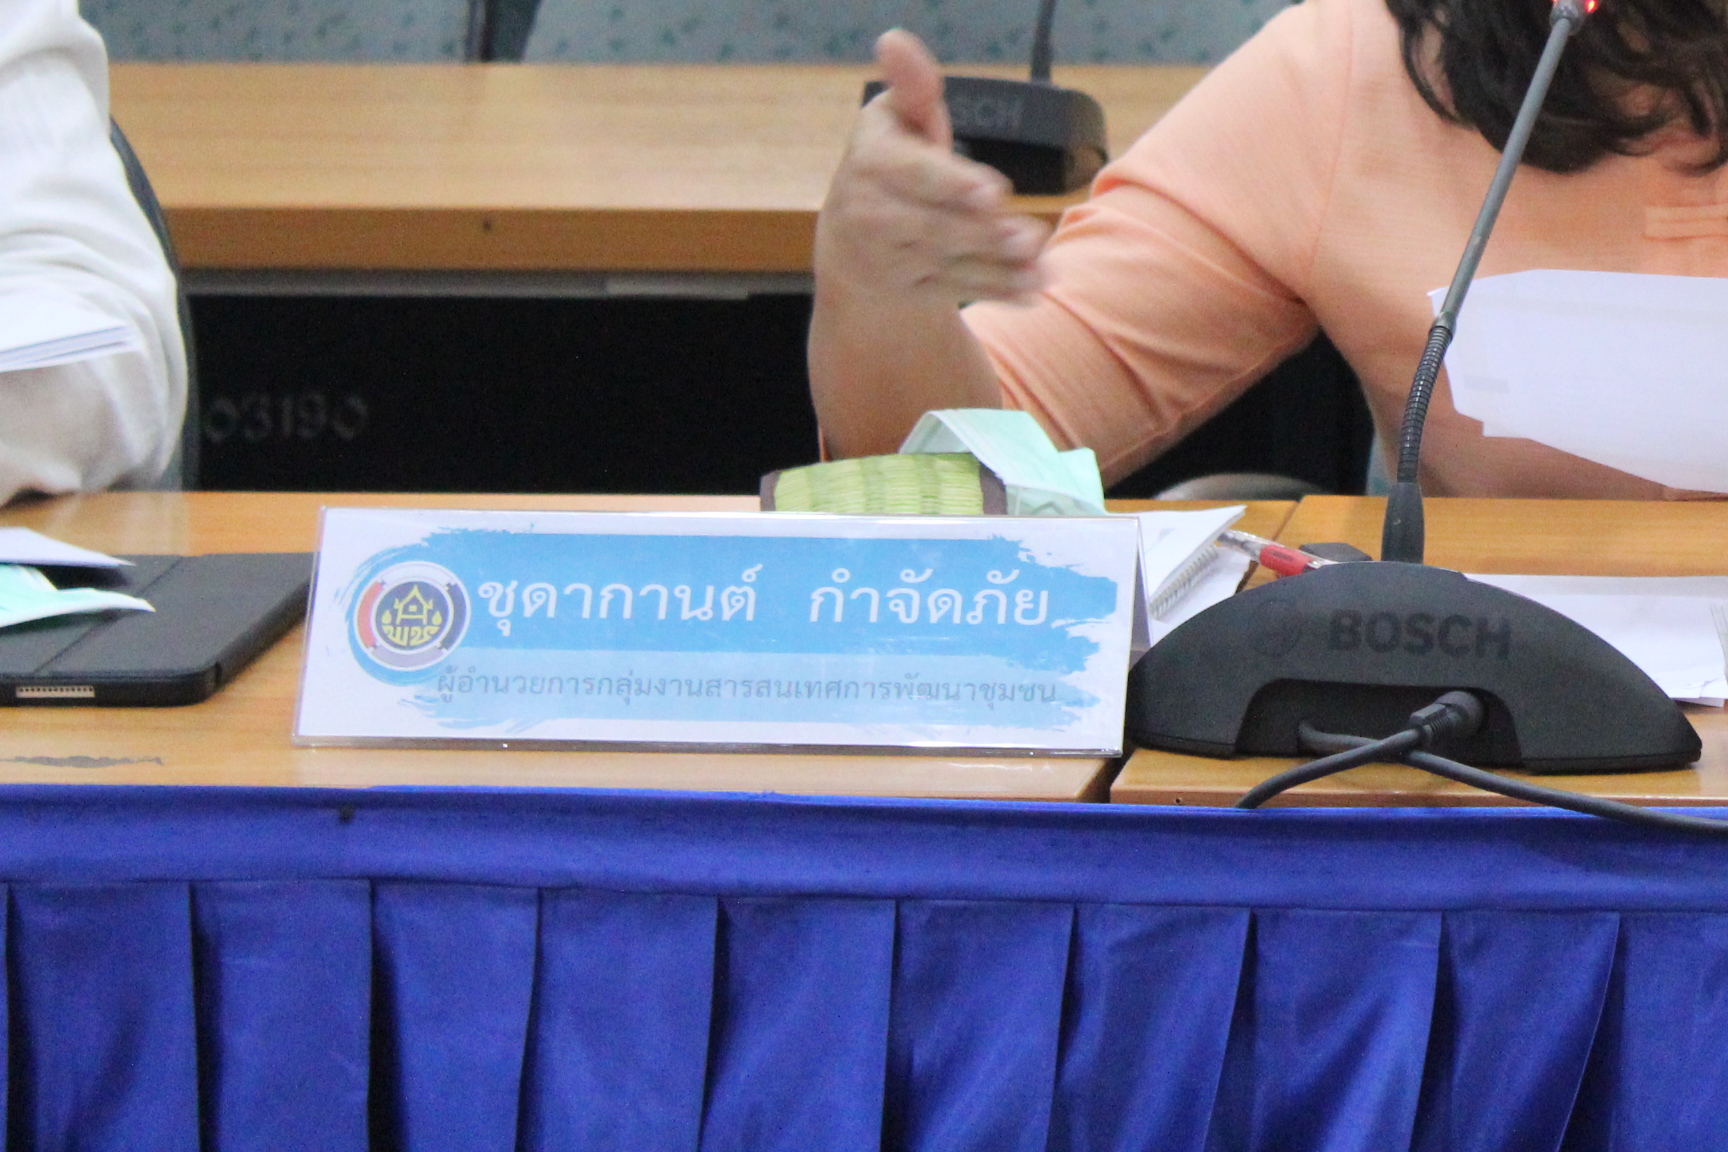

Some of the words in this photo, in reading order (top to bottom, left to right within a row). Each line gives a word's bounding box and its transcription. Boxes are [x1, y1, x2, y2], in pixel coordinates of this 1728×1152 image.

[477, 563, 764, 637] ชุดากานต์
[809, 567, 1050, 626] กำจัดภัย
[1329, 610, 1512, 660] BOSCH
[437, 665, 1058, 709] ผู้อำนวยการกลุ่มงานสารสนเทศการพัฒนาชุมชน
